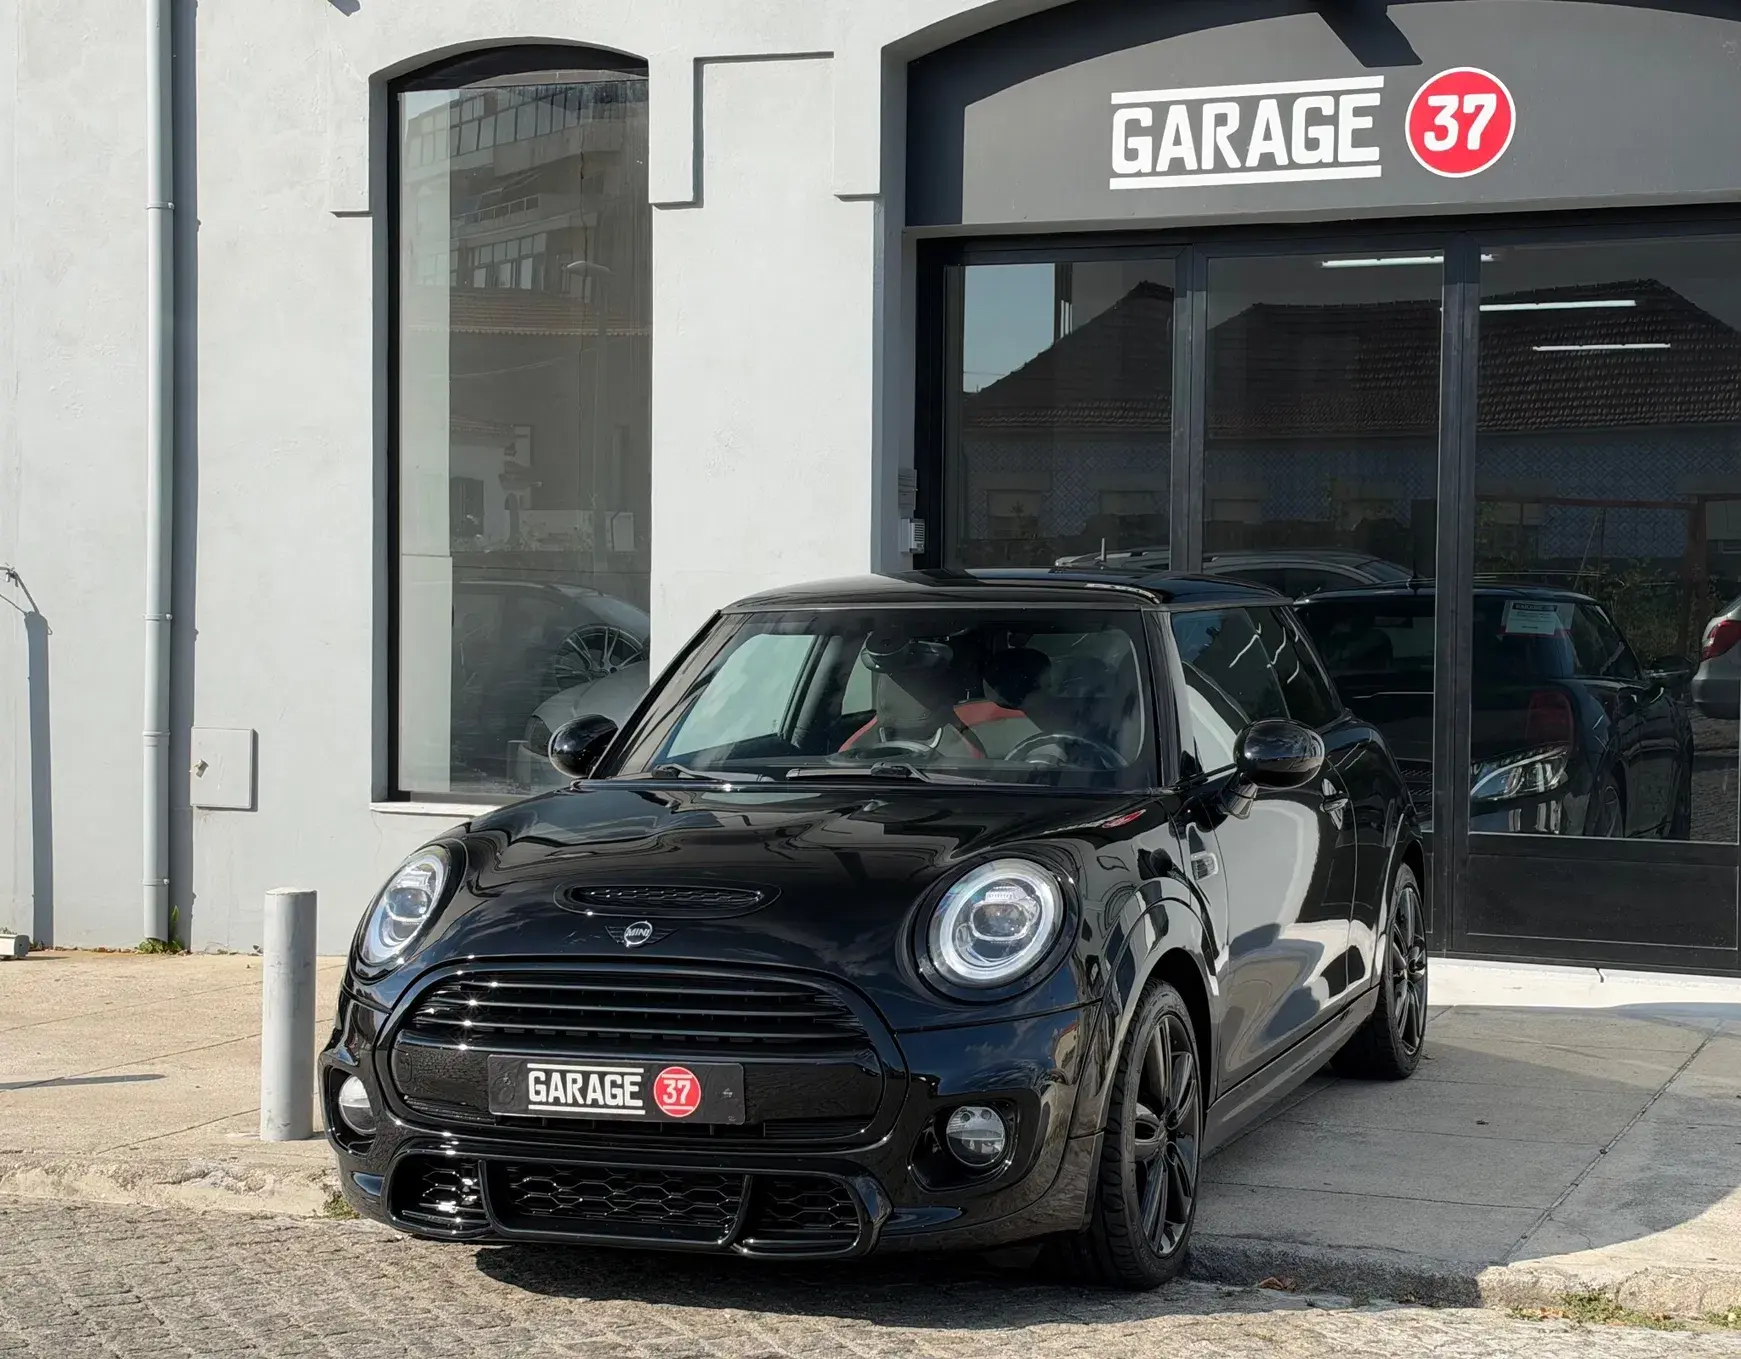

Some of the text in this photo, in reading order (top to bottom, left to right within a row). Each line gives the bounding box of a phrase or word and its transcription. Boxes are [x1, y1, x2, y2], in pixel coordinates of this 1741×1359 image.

[1112, 92, 1497, 174] GARAGE 37
[626, 928, 650, 937] MINI
[528, 1071, 690, 1107] GARAGE 37
